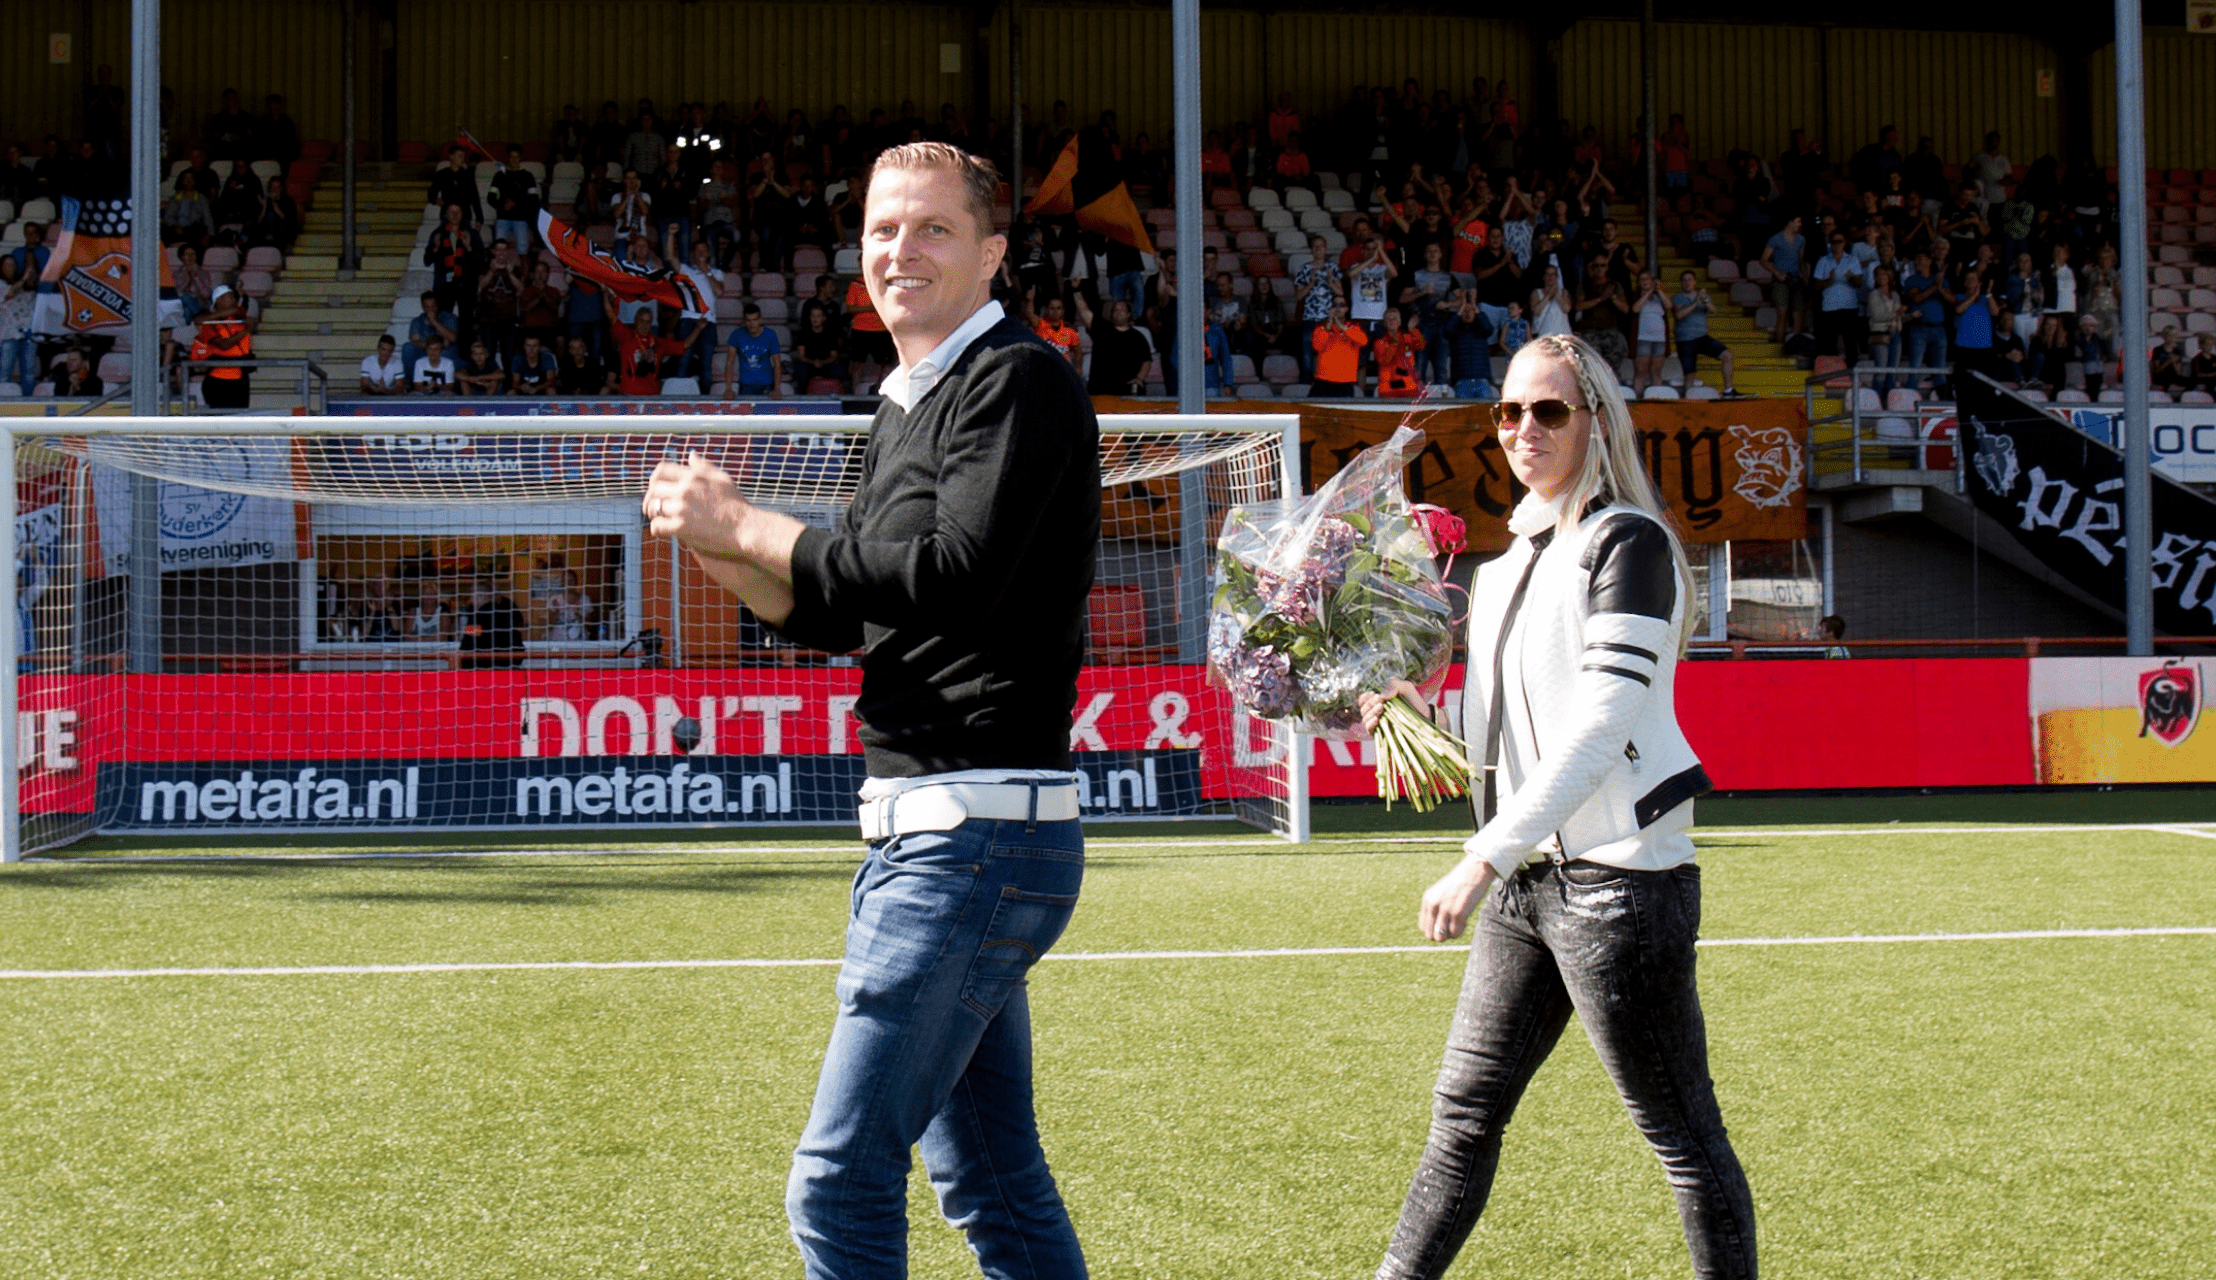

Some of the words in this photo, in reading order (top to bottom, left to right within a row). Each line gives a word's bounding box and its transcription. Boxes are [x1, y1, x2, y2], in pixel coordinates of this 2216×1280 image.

[415, 458, 522, 471] VOLENDAM
[141, 767, 419, 821] metafa.nl
[516, 762, 792, 816] metafa.nl
